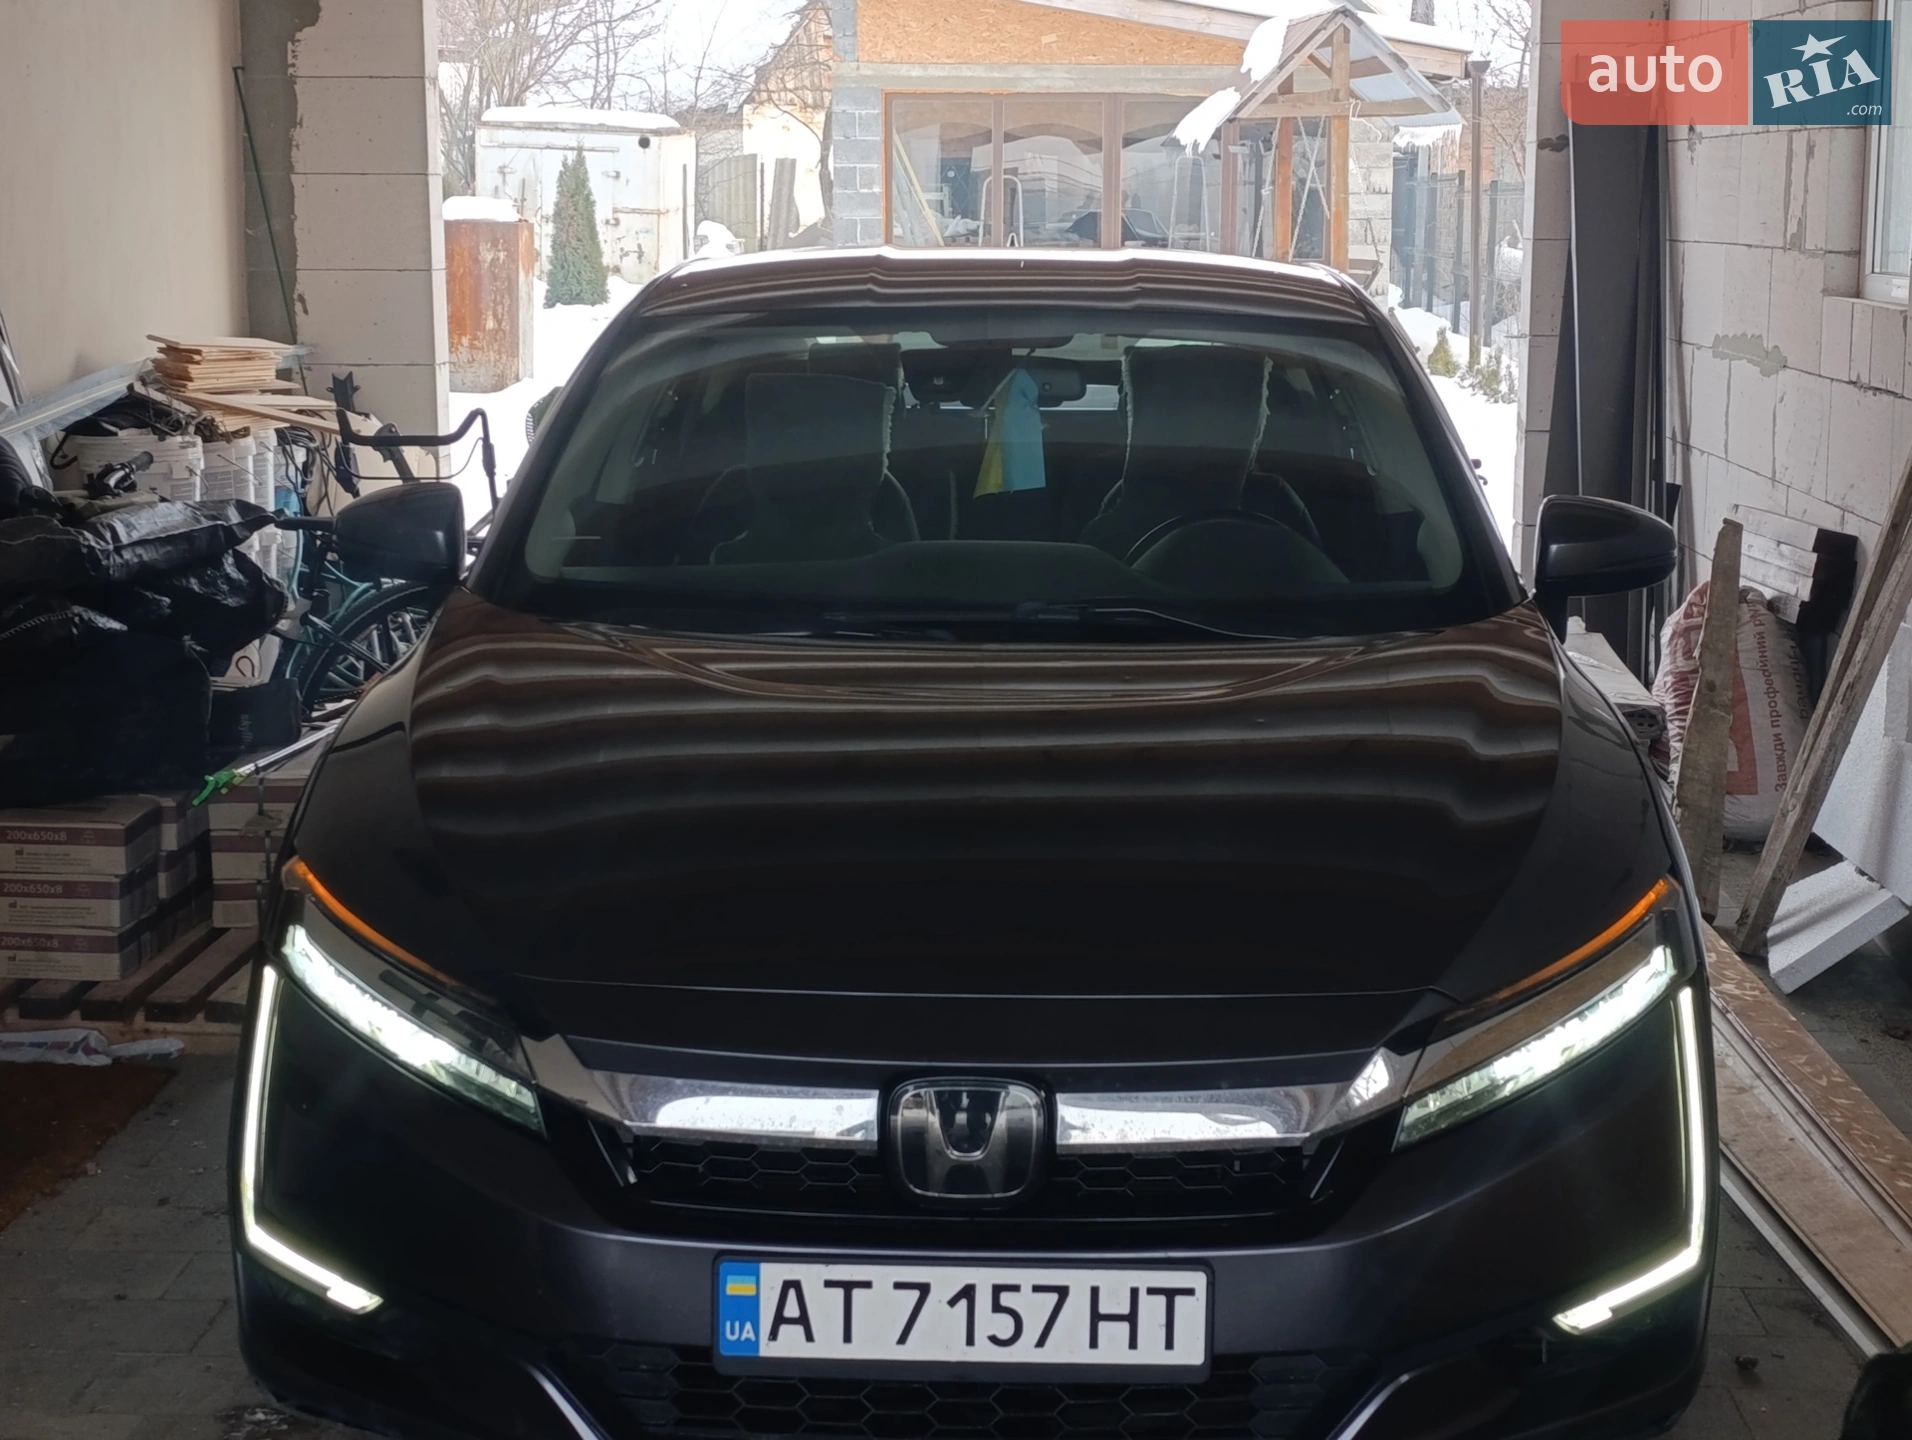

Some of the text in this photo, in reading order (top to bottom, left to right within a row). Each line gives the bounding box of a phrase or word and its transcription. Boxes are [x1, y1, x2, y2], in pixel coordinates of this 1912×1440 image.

[1774, 733, 1788, 793] Завжди
[6, 830, 67, 842] 200x650x8
[3, 882, 63, 894] 200x650x8
[767, 1278, 1196, 1351] AT 7157 HT
[725, 1320, 756, 1342] UA
